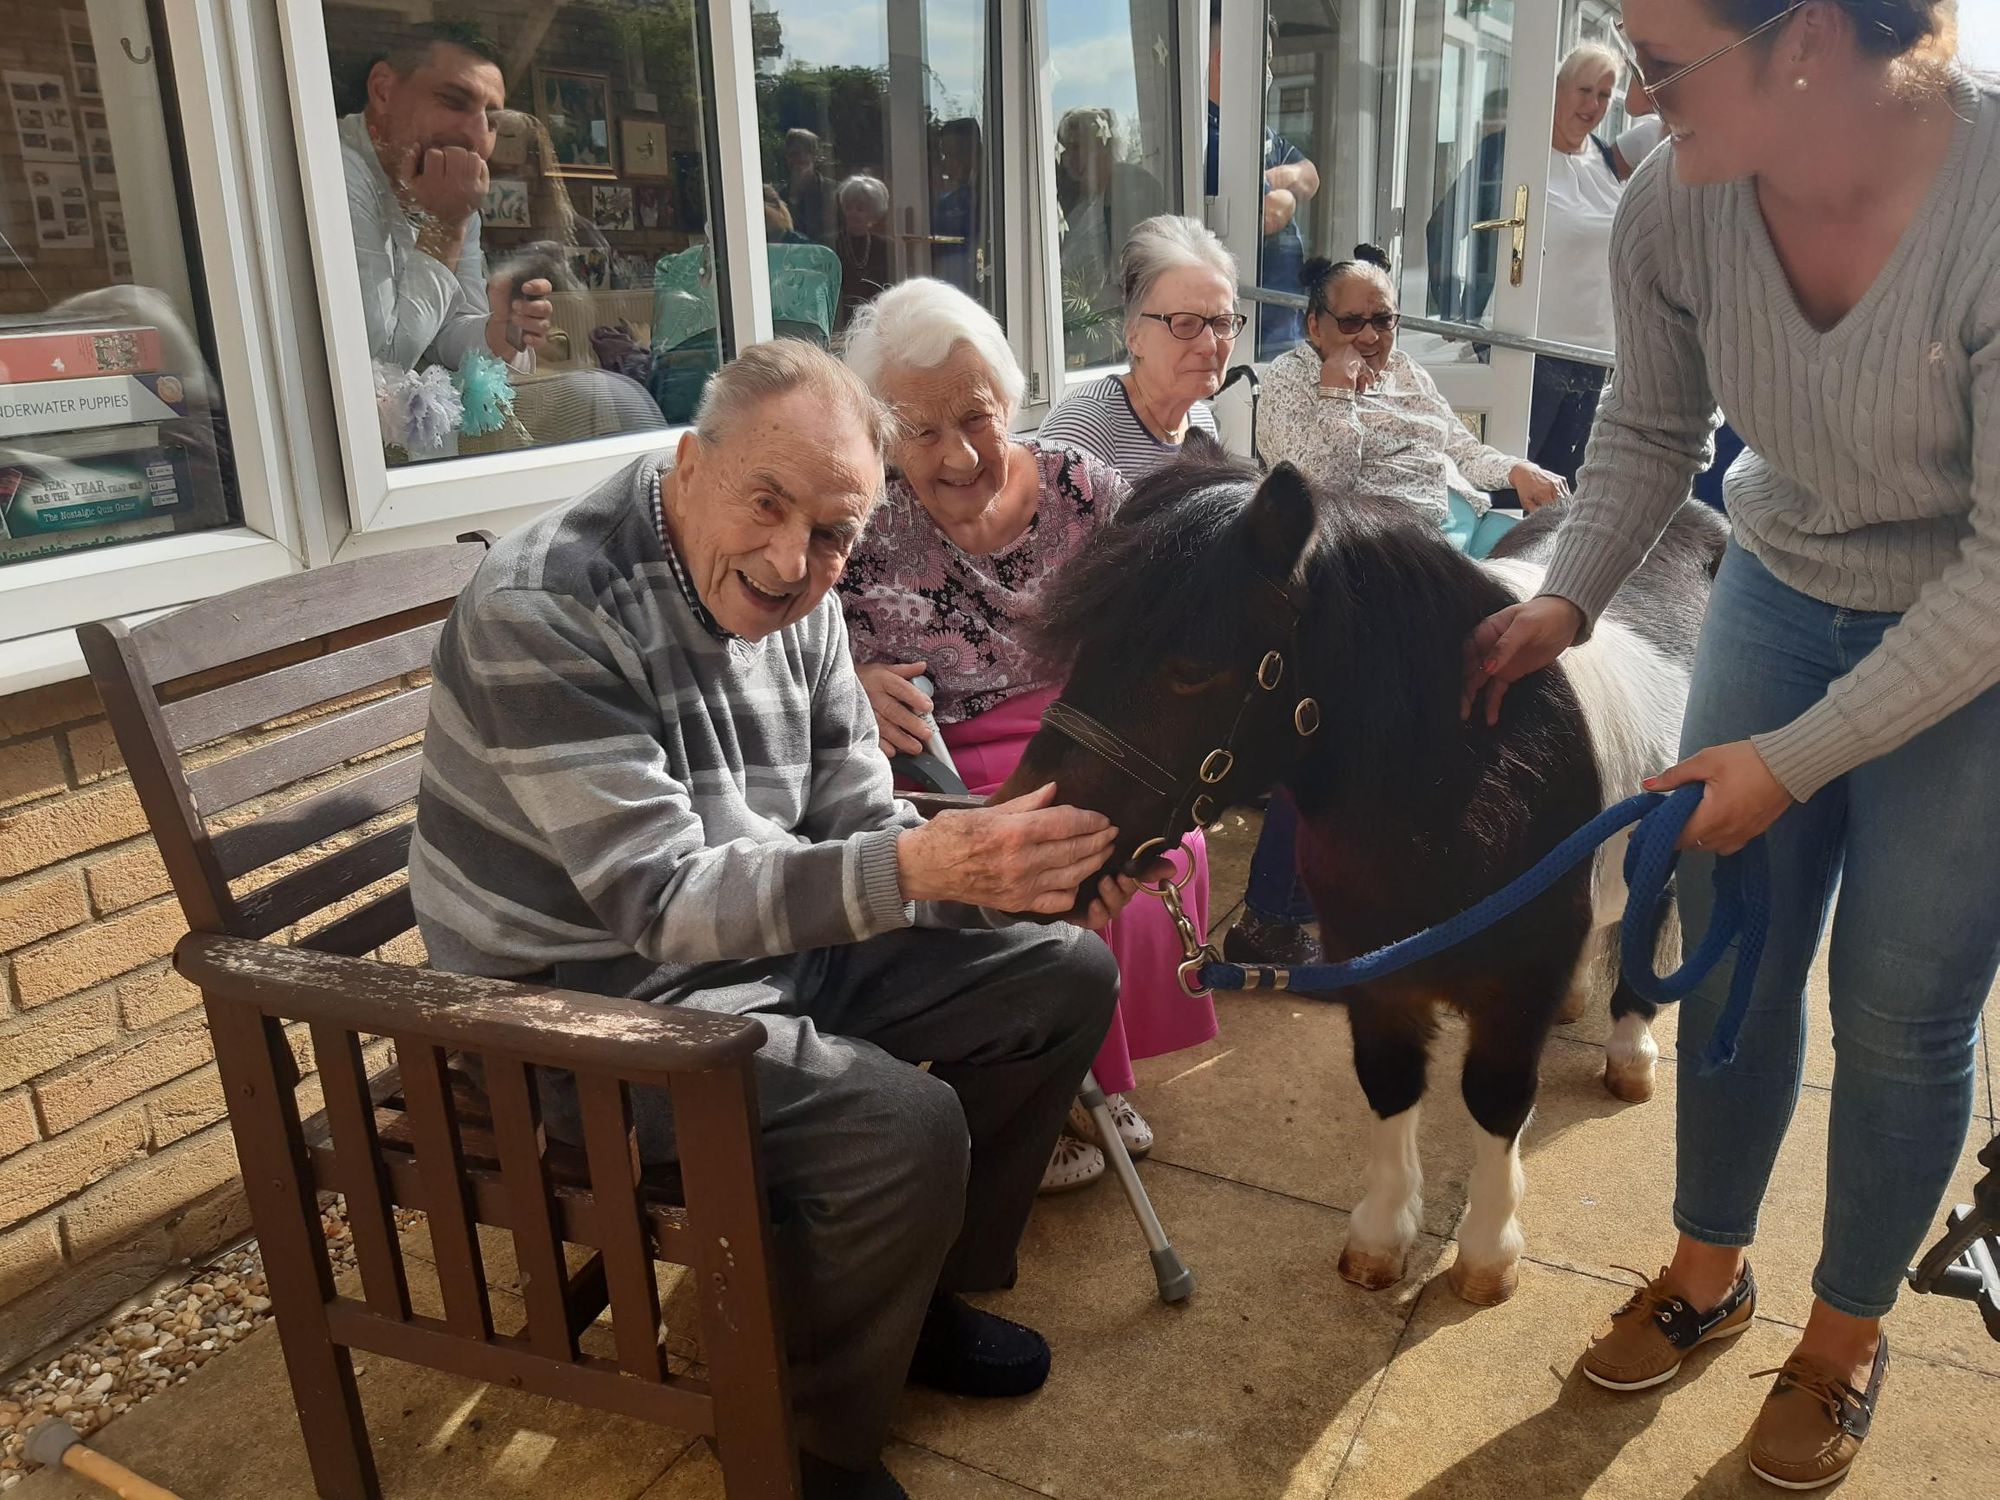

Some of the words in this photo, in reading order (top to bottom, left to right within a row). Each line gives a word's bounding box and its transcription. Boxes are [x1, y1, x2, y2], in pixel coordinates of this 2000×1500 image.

[79, 394, 129, 411] PUPPIES
[71, 480, 107, 496] YEAR
[52, 491, 70, 502] THE
[43, 513, 59, 522] The
[61, 507, 96, 520] Nostalgic
